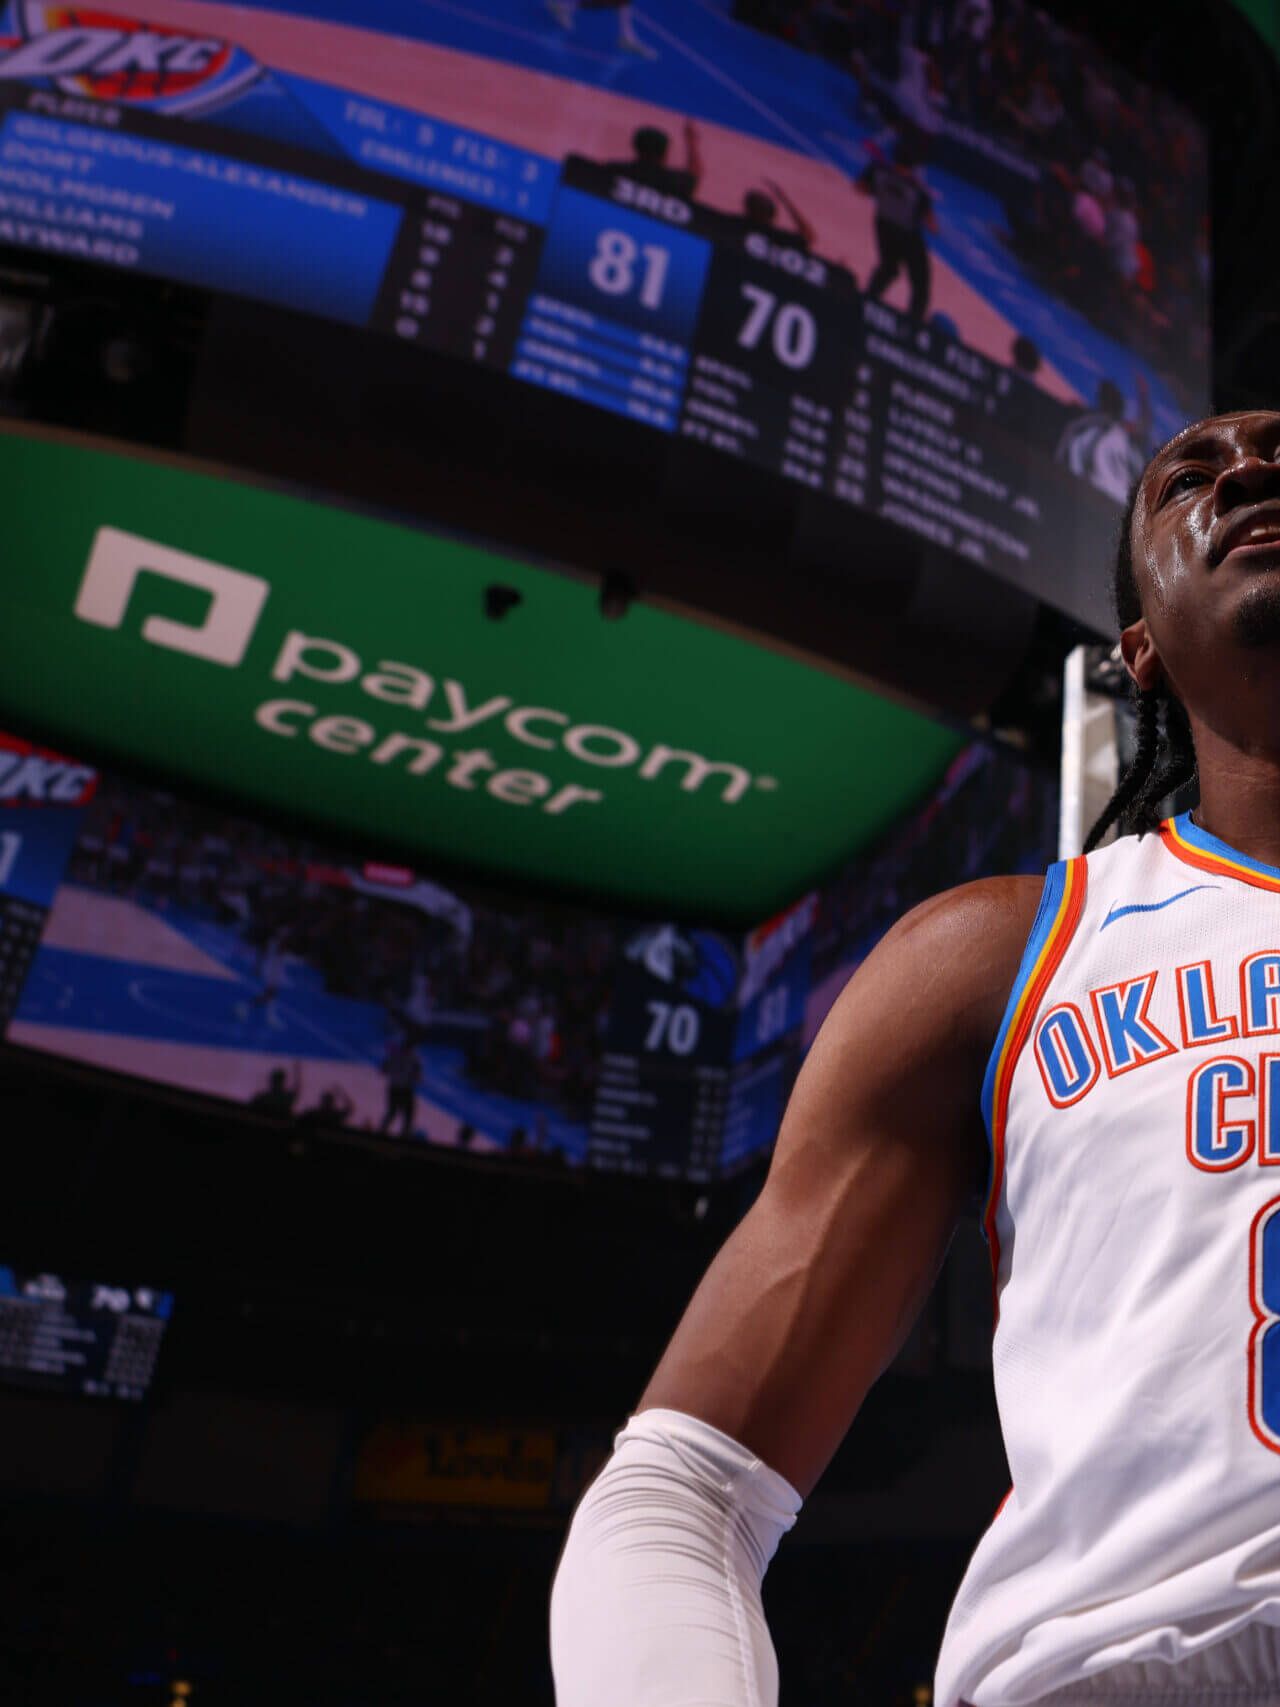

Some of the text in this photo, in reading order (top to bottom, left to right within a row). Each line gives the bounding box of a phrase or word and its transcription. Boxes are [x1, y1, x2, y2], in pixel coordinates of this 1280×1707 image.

[0, 216, 141, 264] AYWARD
[610, 174, 694, 226] 3RD
[588, 227, 671, 312] 81
[737, 281, 819, 371] 70
[254, 698, 604, 816] center
[272, 629, 752, 804] paycom
[642, 998, 701, 1057] 70
